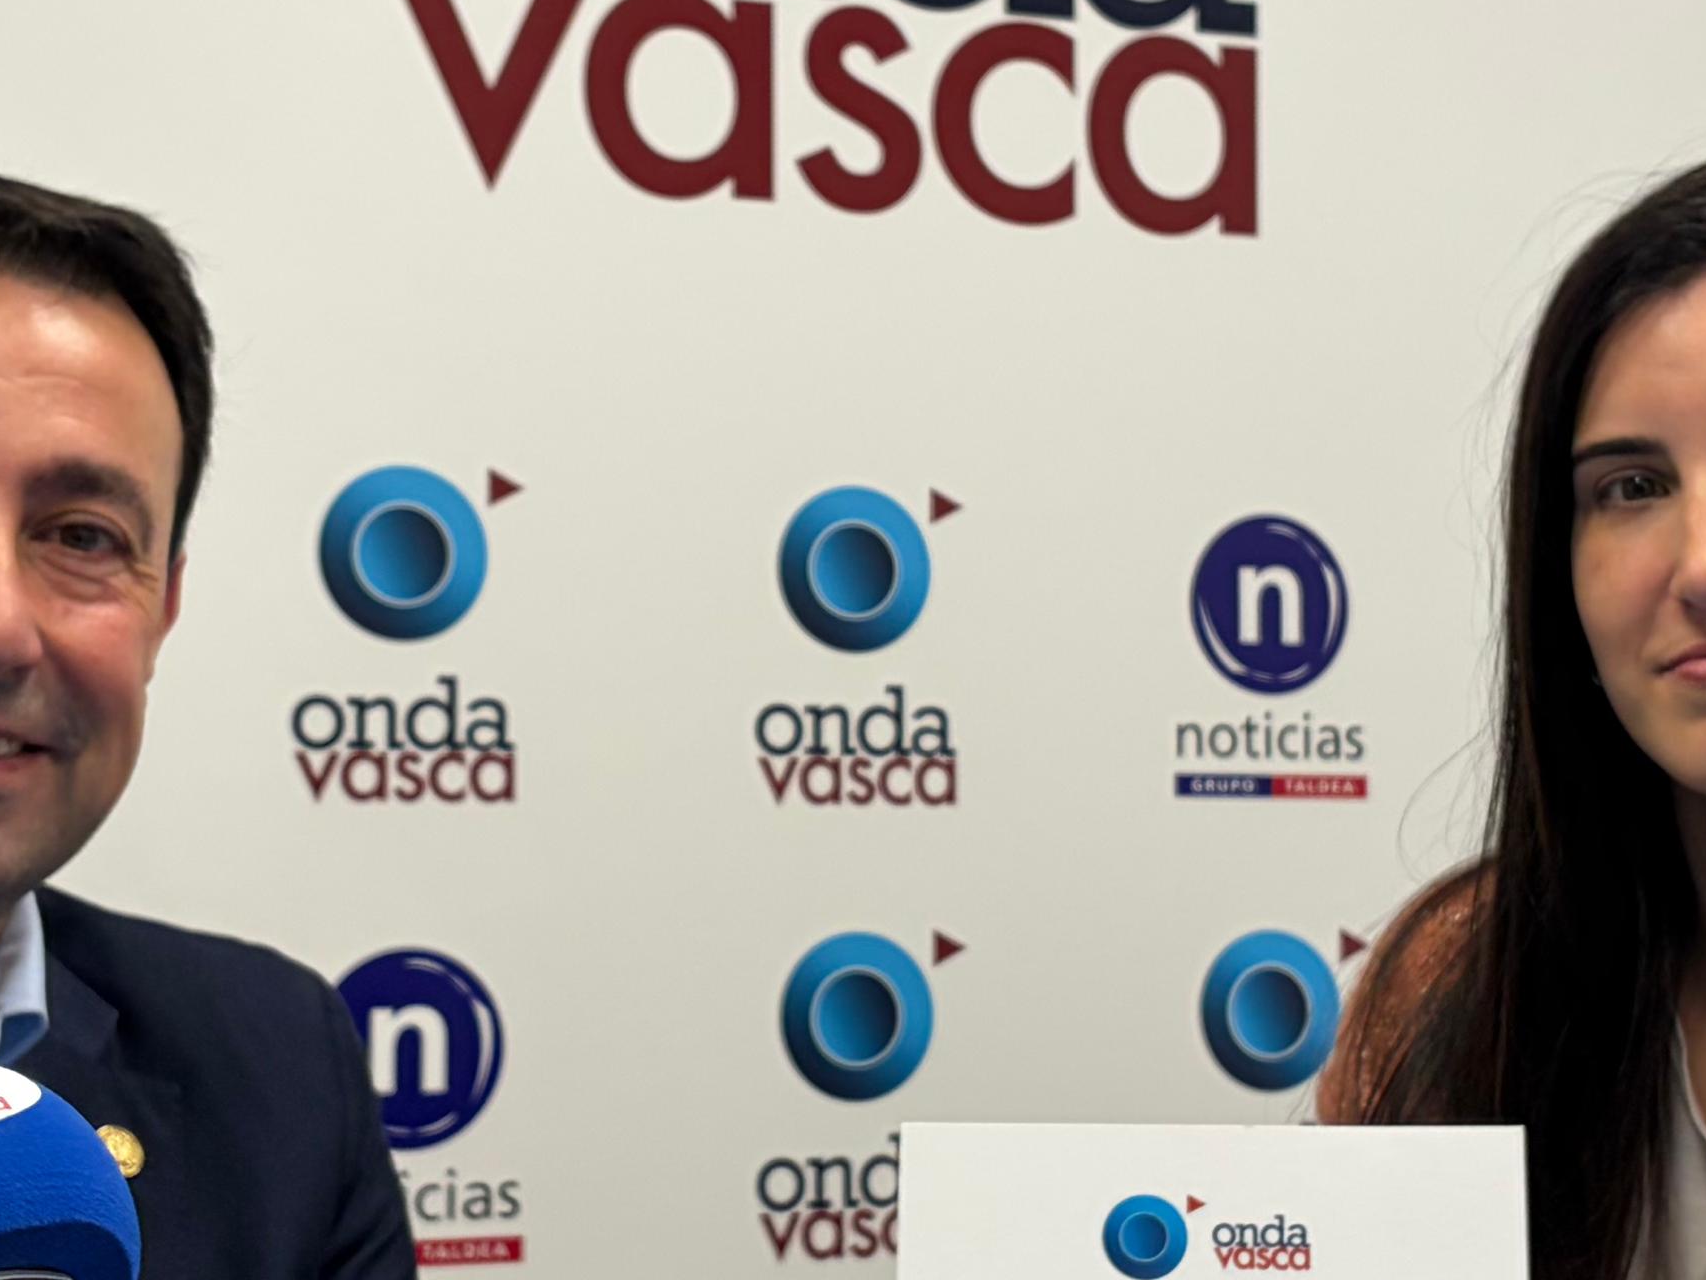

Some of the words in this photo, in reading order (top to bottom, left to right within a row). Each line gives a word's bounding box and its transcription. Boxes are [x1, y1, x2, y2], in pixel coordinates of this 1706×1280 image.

[1237, 564, 1305, 646] n
[292, 675, 515, 751] onda
[755, 685, 956, 757] onda
[1175, 710, 1365, 760] noticias
[294, 749, 515, 803] vasca
[757, 755, 957, 806] vasca
[1190, 778, 1256, 793] GRUPO
[1284, 779, 1355, 794] TALDEA
[368, 1004, 449, 1096] n
[401, 1169, 522, 1222] cias
[1212, 1214, 1311, 1248] onda
[1214, 1246, 1311, 1271] vasca
